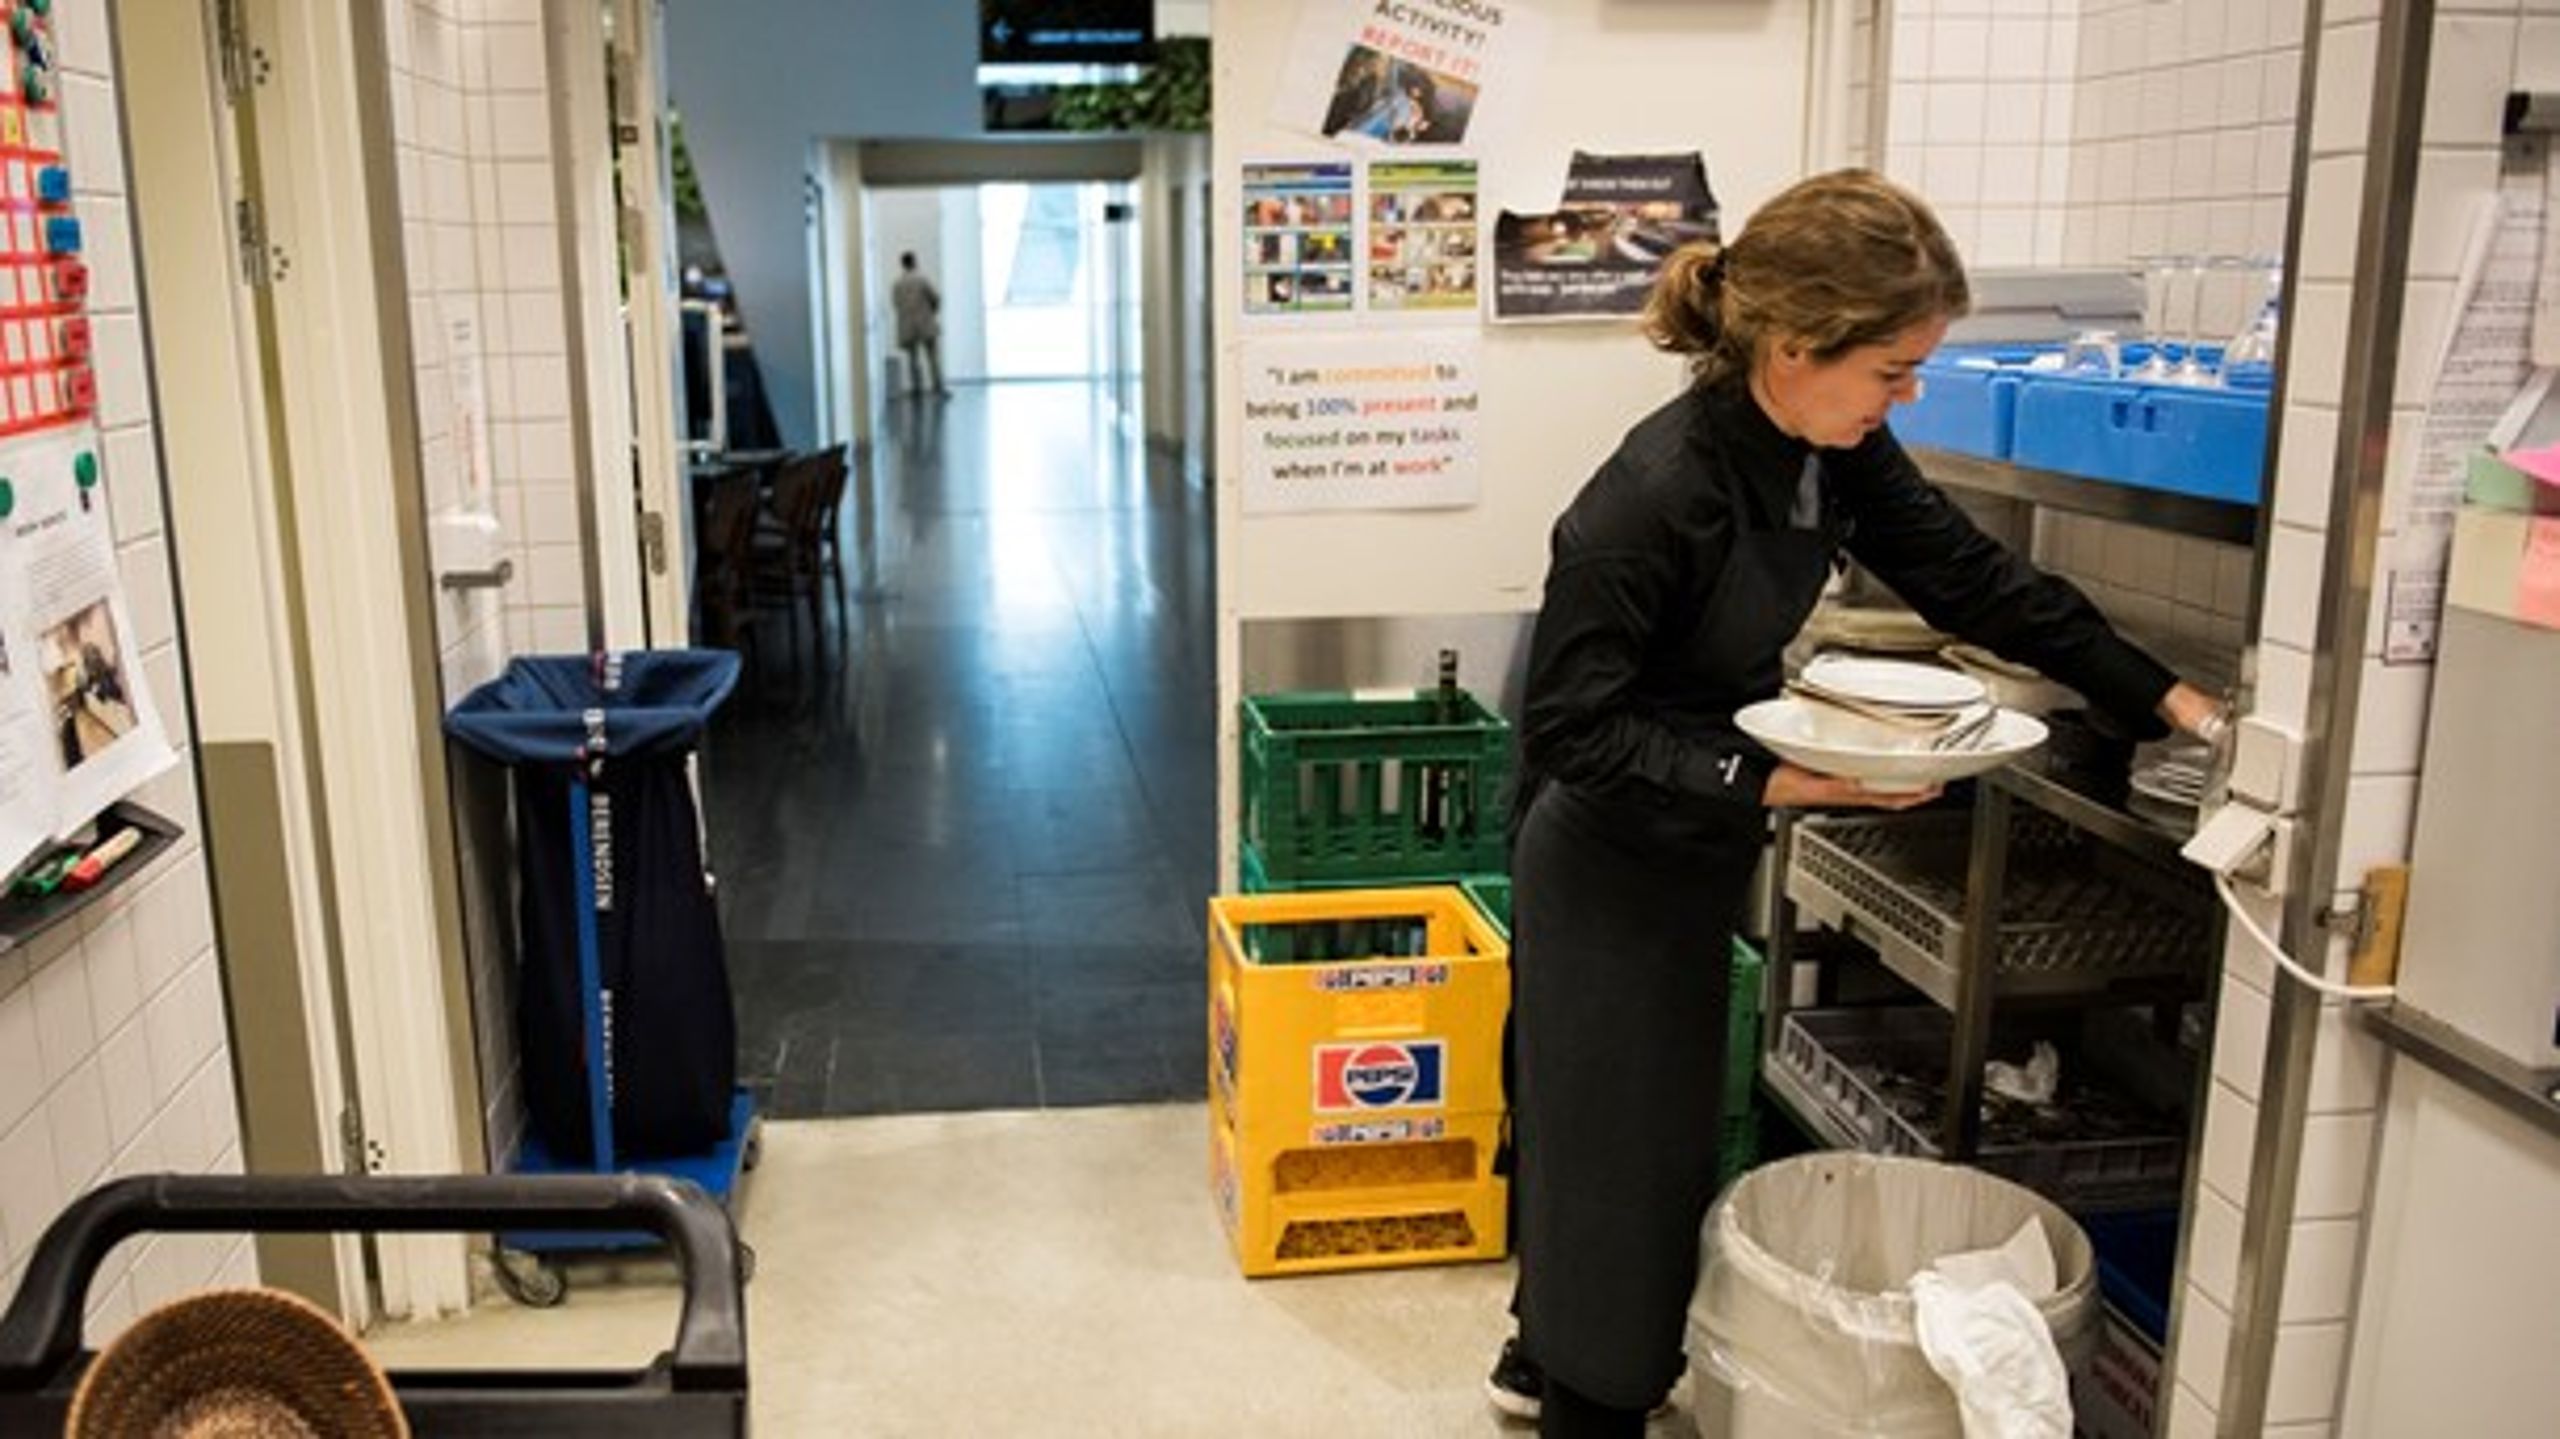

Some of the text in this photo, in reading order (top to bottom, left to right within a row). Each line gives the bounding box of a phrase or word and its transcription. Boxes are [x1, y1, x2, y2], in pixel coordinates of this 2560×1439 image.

[1375, 0, 1486, 47] ACTIVITY!
[1361, 25, 1446, 63] REPORT
[1289, 371, 1318, 384] am
[1325, 366, 1431, 383] committed
[1436, 364, 1458, 381] to
[1246, 394, 1478, 420] being 100% present and
[1263, 429, 1460, 449] focused on my tasks
[1273, 462, 1326, 479] when
[1332, 460, 1363, 476] I'm
[1368, 459, 1387, 475] at
[591, 793, 614, 911] BERENDSEN
[1346, 1066, 1414, 1085] PEPSI
